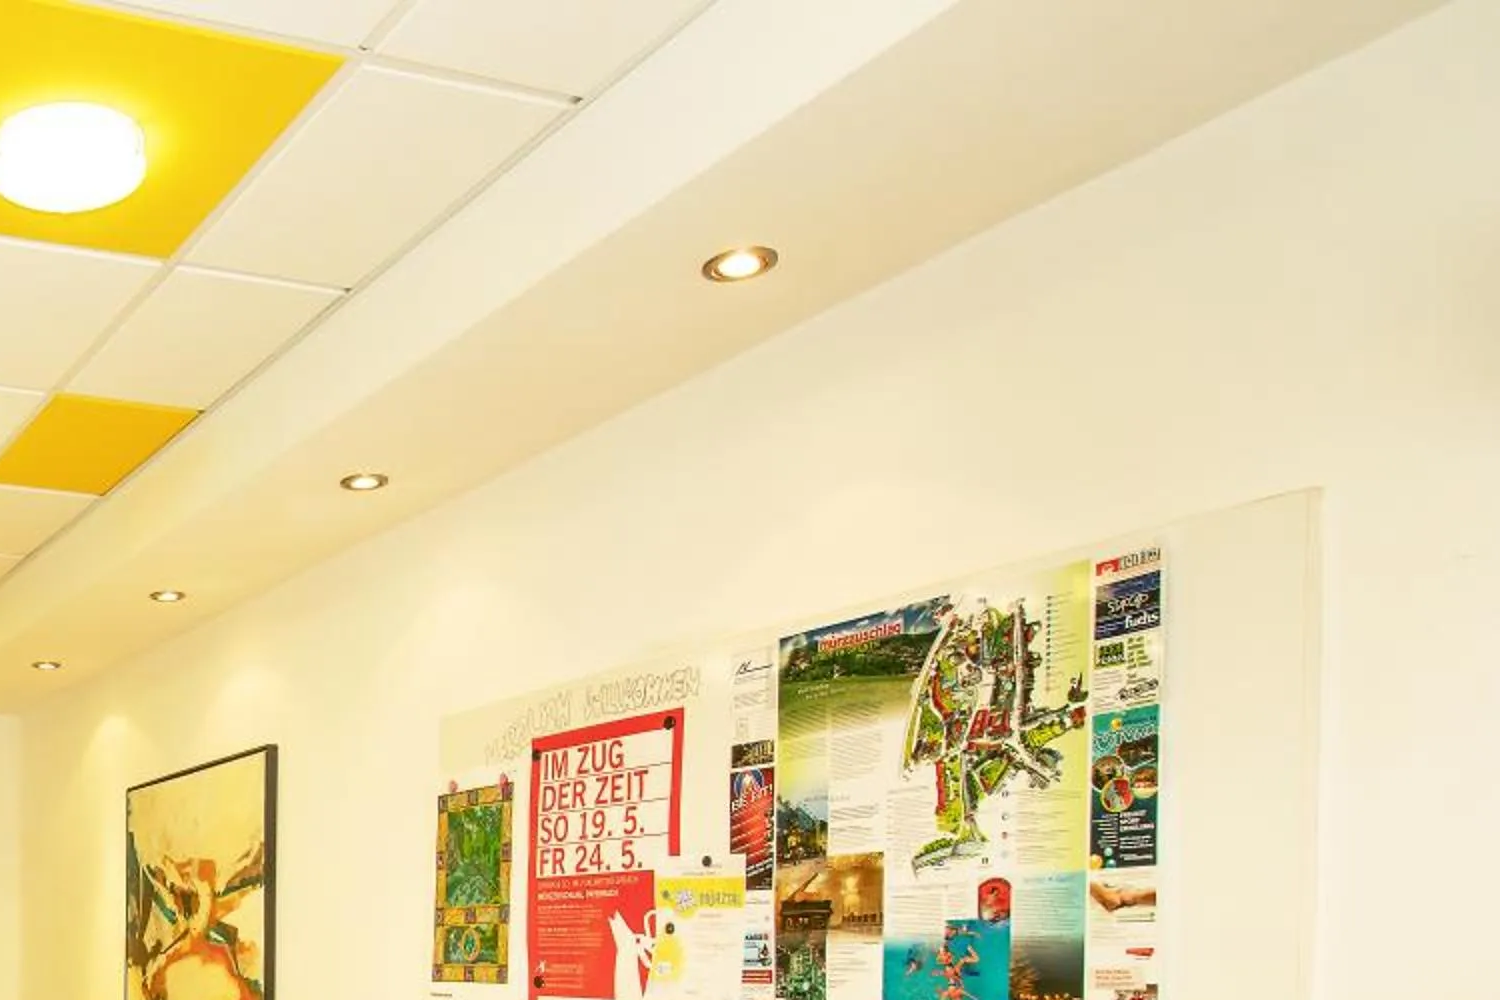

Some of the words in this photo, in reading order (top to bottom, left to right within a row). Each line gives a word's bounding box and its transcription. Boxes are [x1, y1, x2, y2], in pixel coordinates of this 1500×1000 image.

[542, 749, 569, 781] IM
[576, 739, 625, 775] ZUG
[540, 779, 586, 812] DER
[594, 768, 649, 805] ZEIT
[539, 814, 569, 845] SO
[579, 809, 613, 840] 19.
[623, 805, 646, 834] 5.
[539, 845, 566, 876] FR
[574, 842, 612, 872] 24.
[621, 839, 644, 868] 5.
